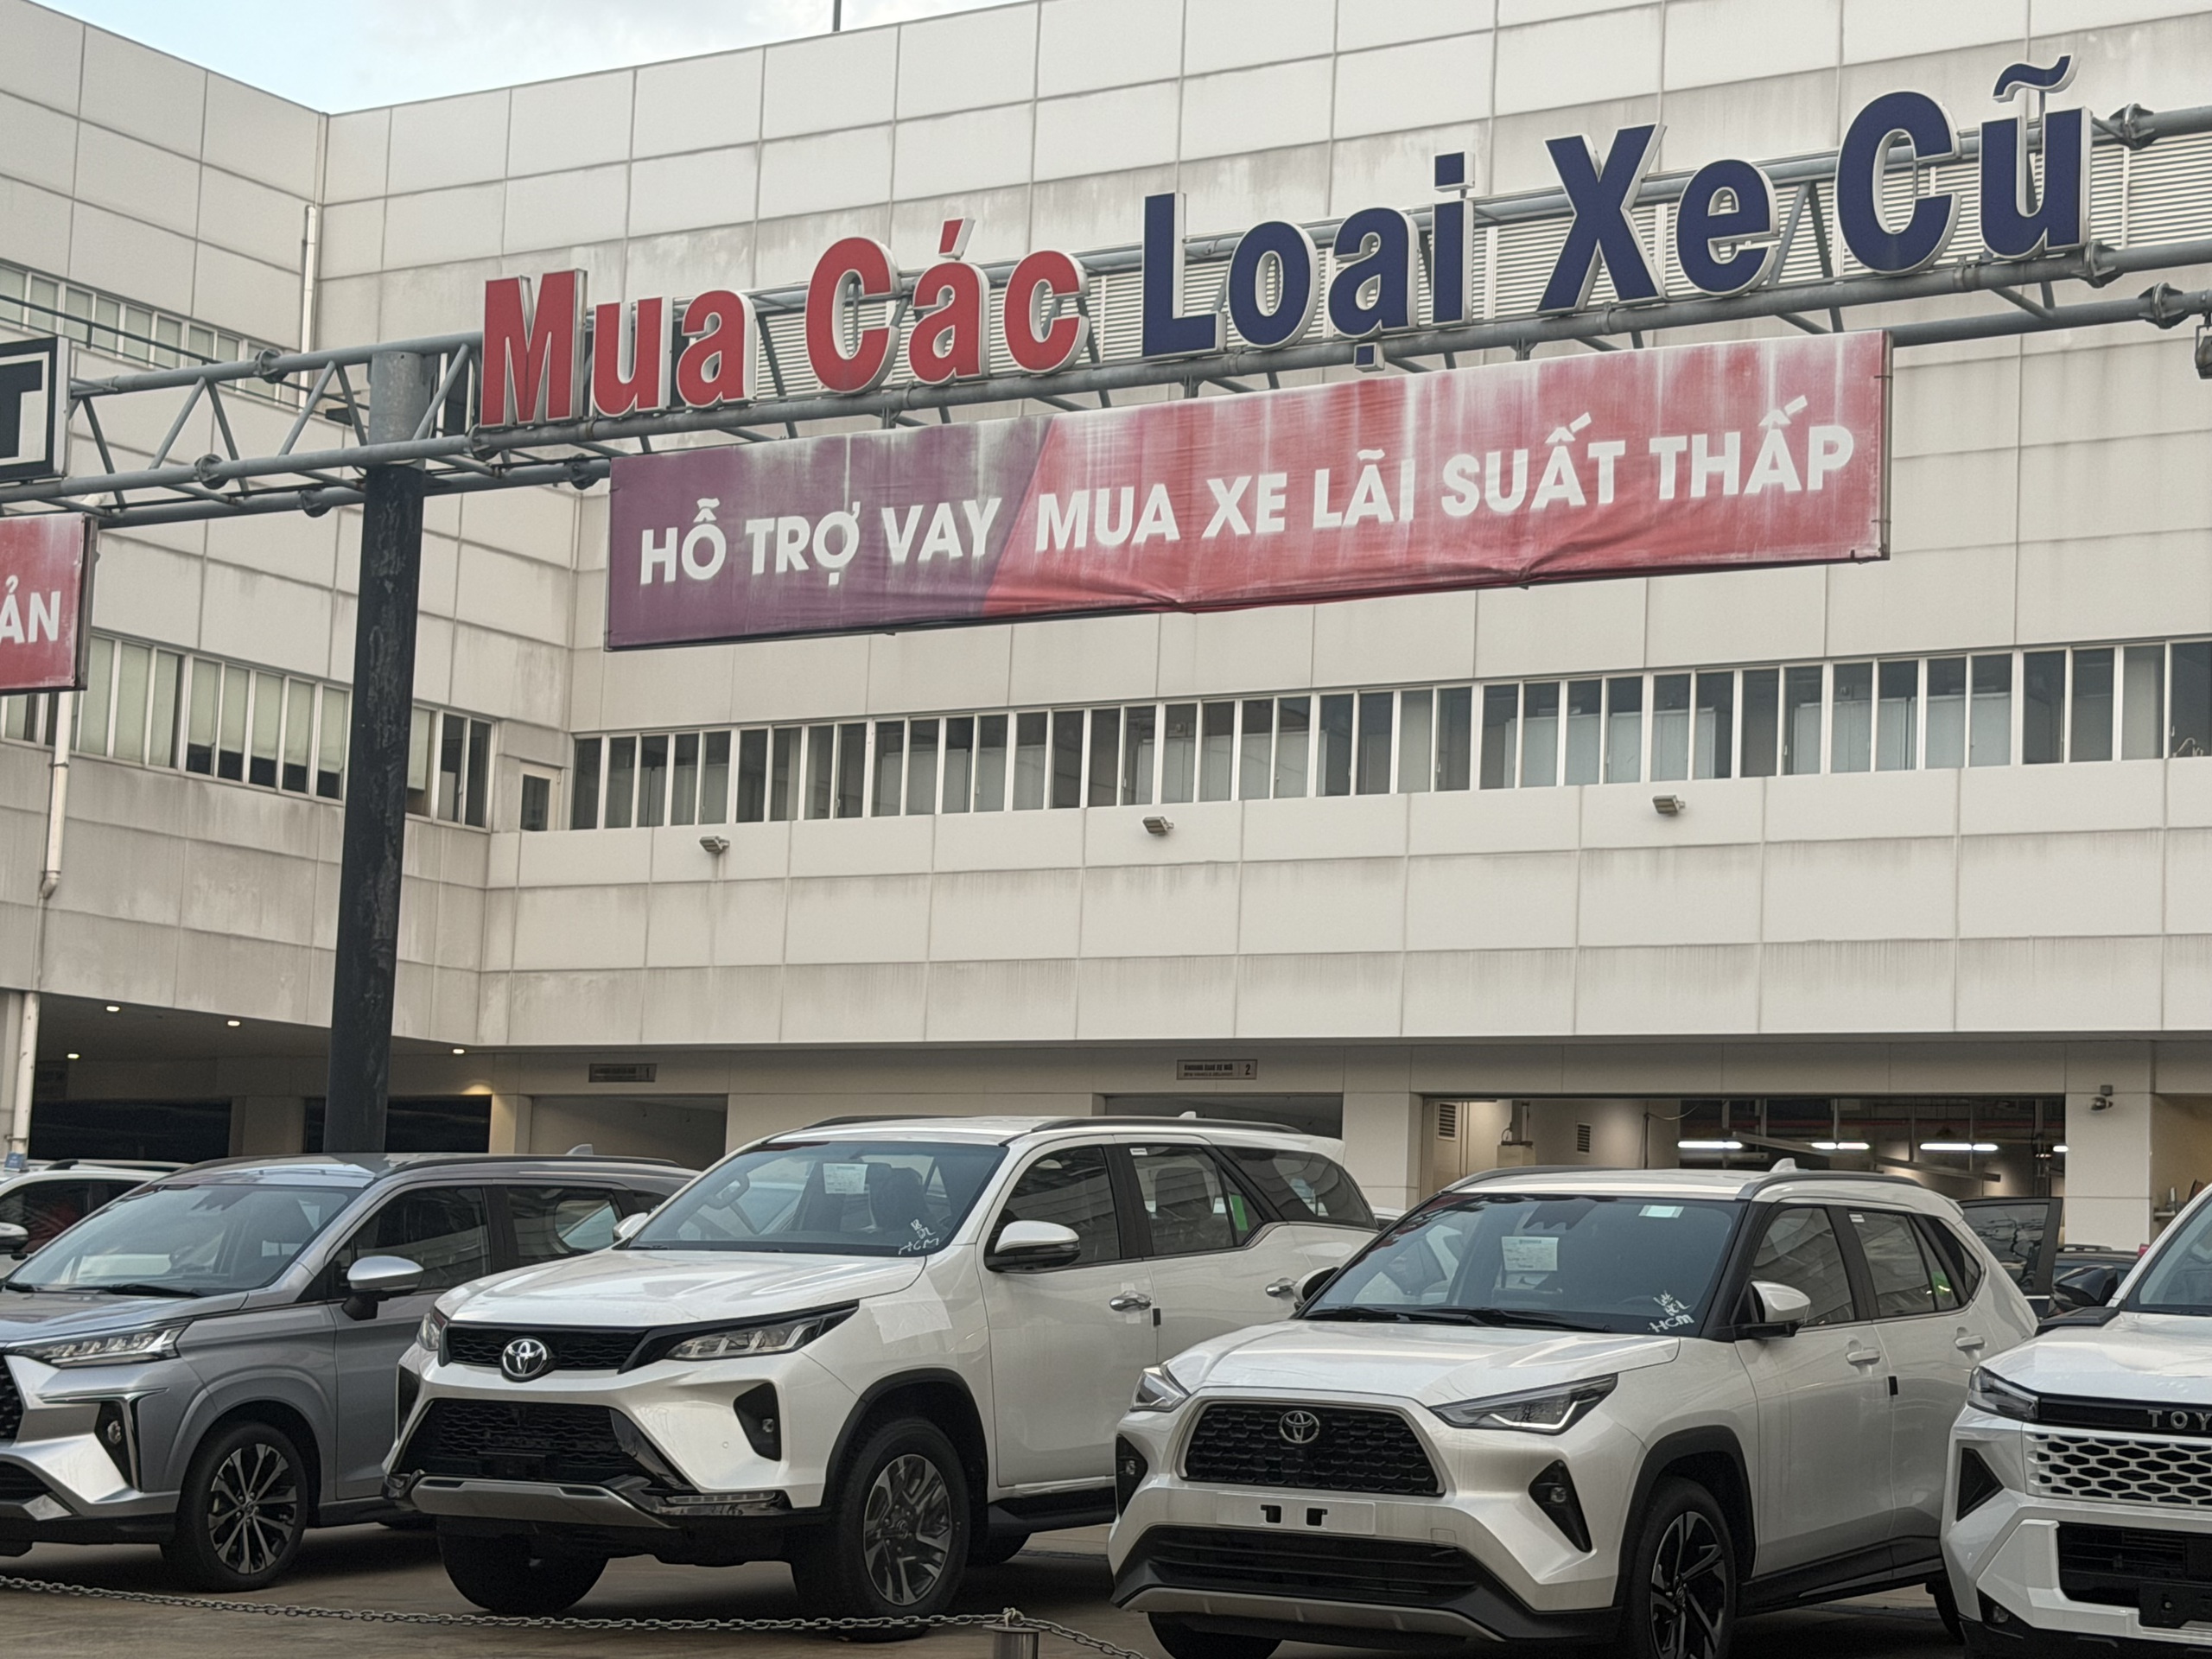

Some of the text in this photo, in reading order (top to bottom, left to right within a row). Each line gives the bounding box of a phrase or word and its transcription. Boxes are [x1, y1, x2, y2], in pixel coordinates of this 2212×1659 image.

[480, 54, 2092, 427] Mua Các Loại Xe Cũ
[639, 395, 1855, 586] HỖ TRỢ VAY MUA XE LÃI SUẤT THẤP
[1245, 1064, 1251, 1075] 2
[2147, 1409, 2212, 1431] TOY
